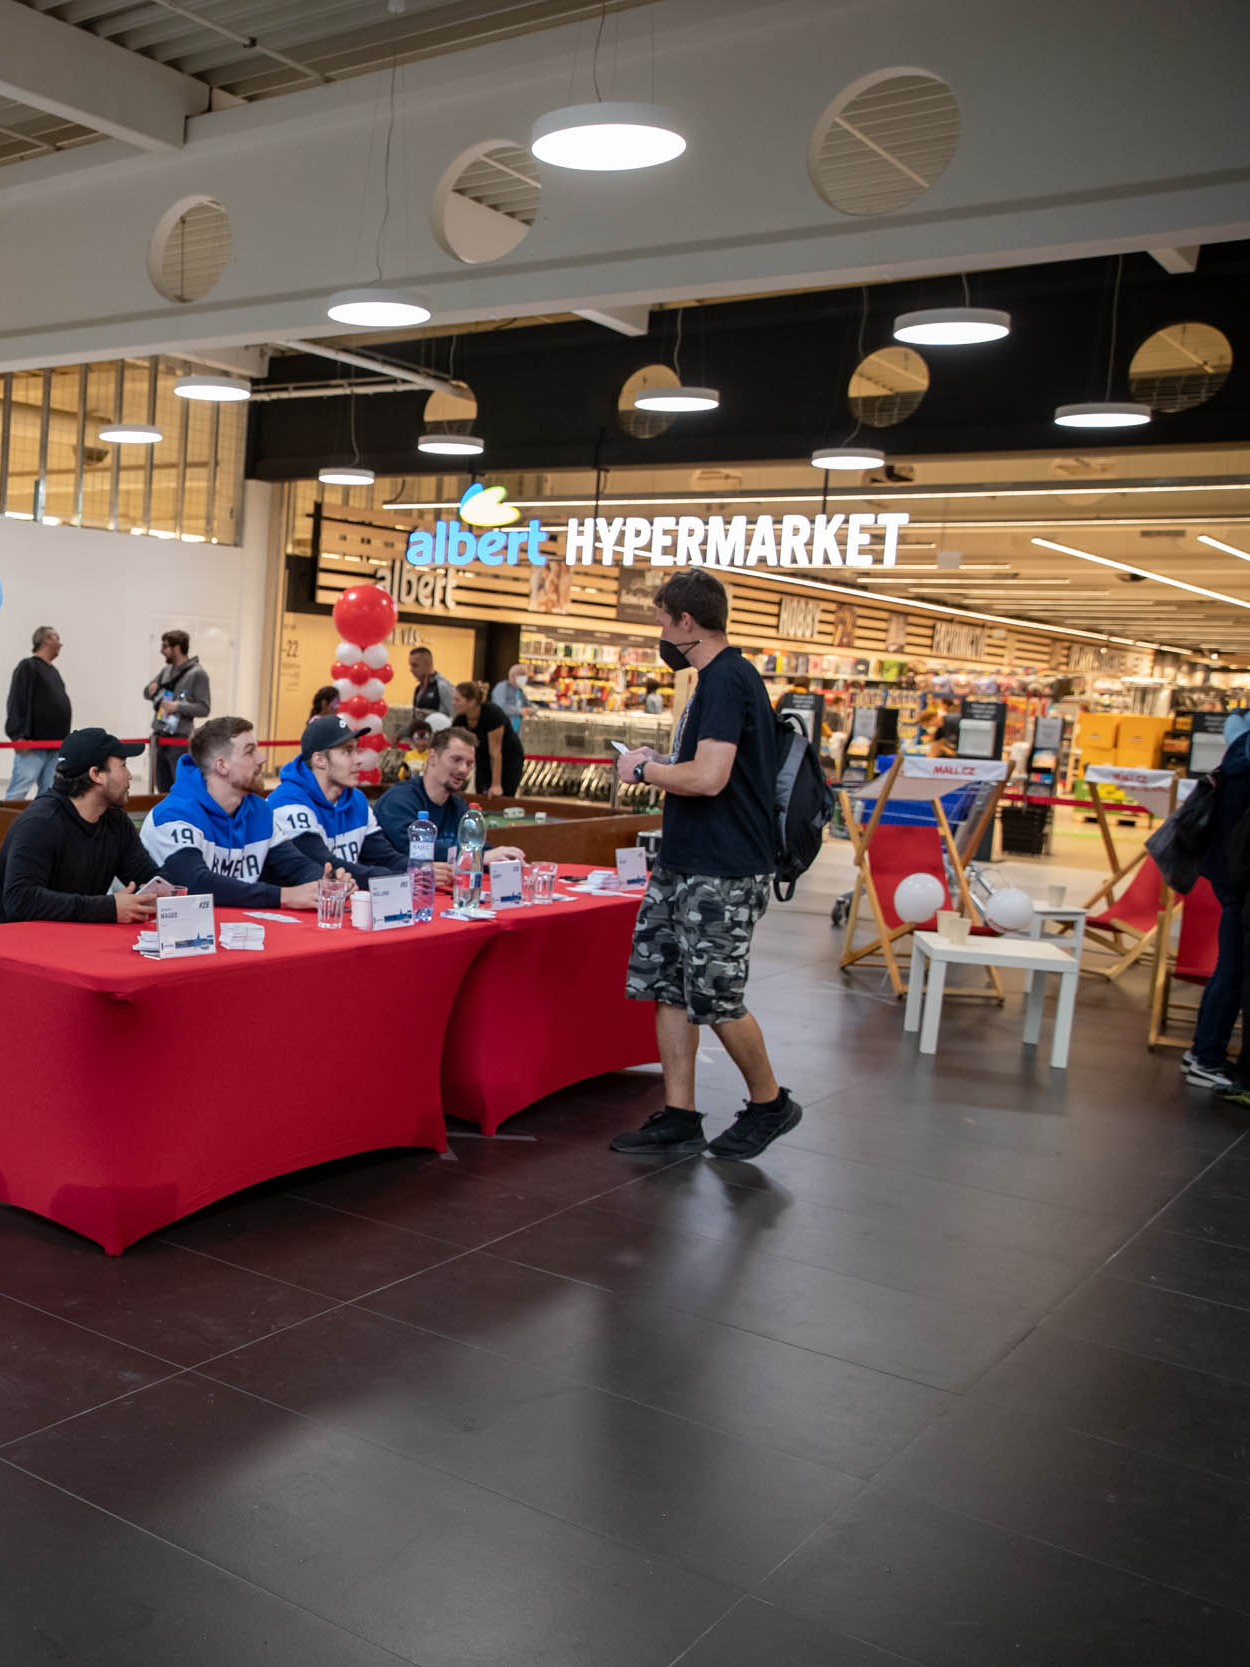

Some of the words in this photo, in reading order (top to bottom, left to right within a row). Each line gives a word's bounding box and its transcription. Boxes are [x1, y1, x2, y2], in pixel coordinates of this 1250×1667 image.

[406, 519, 548, 566] albert
[565, 512, 910, 567] HYPERMARKET
[376, 559, 458, 609] albert
[933, 765, 975, 776] MALL.CZ
[287, 812, 311, 829] 19
[171, 828, 195, 845] 19
